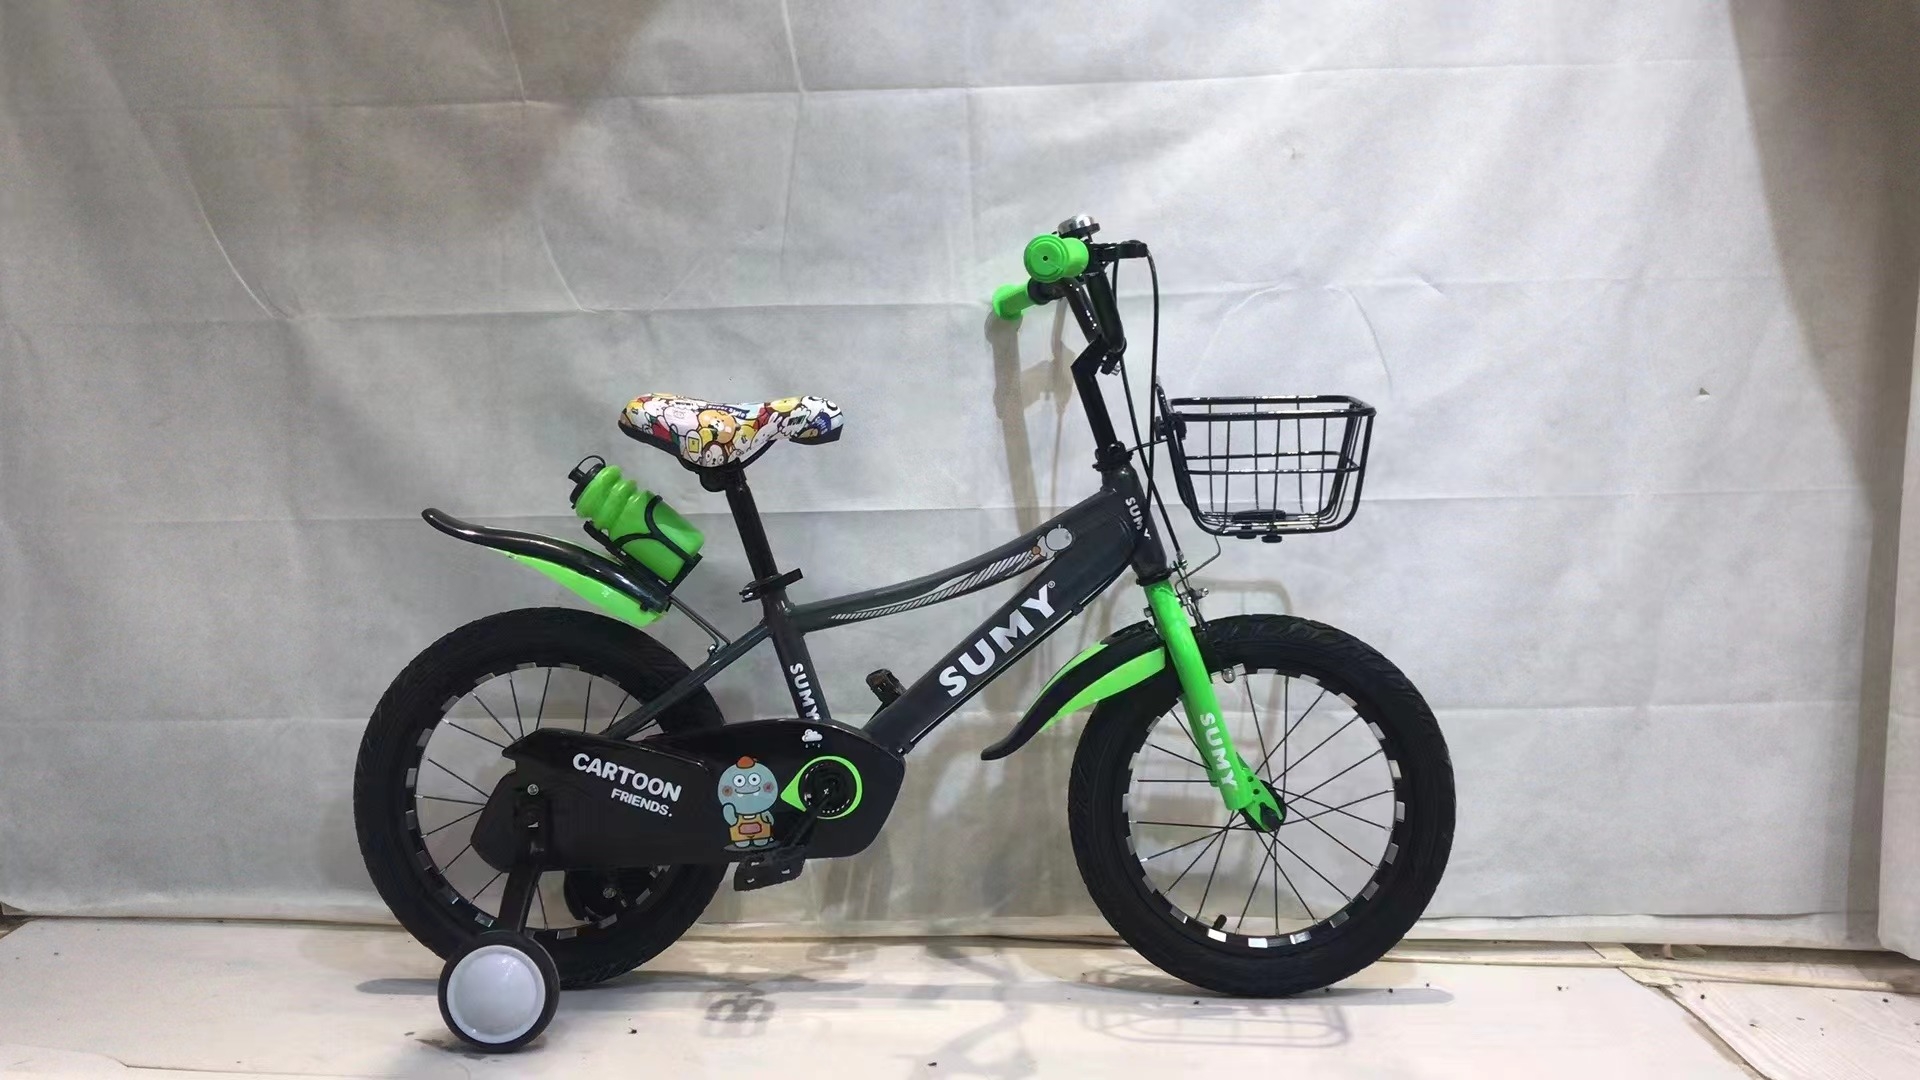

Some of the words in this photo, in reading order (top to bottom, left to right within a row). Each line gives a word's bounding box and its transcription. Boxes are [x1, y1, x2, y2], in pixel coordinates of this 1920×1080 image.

[939, 583, 1056, 697] SUMY
[790, 663, 820, 720] SUMY
[572, 753, 682, 802] CARTOON
[1200, 713, 1238, 790] SUMY
[611, 788, 672, 817] FRIENDS.
